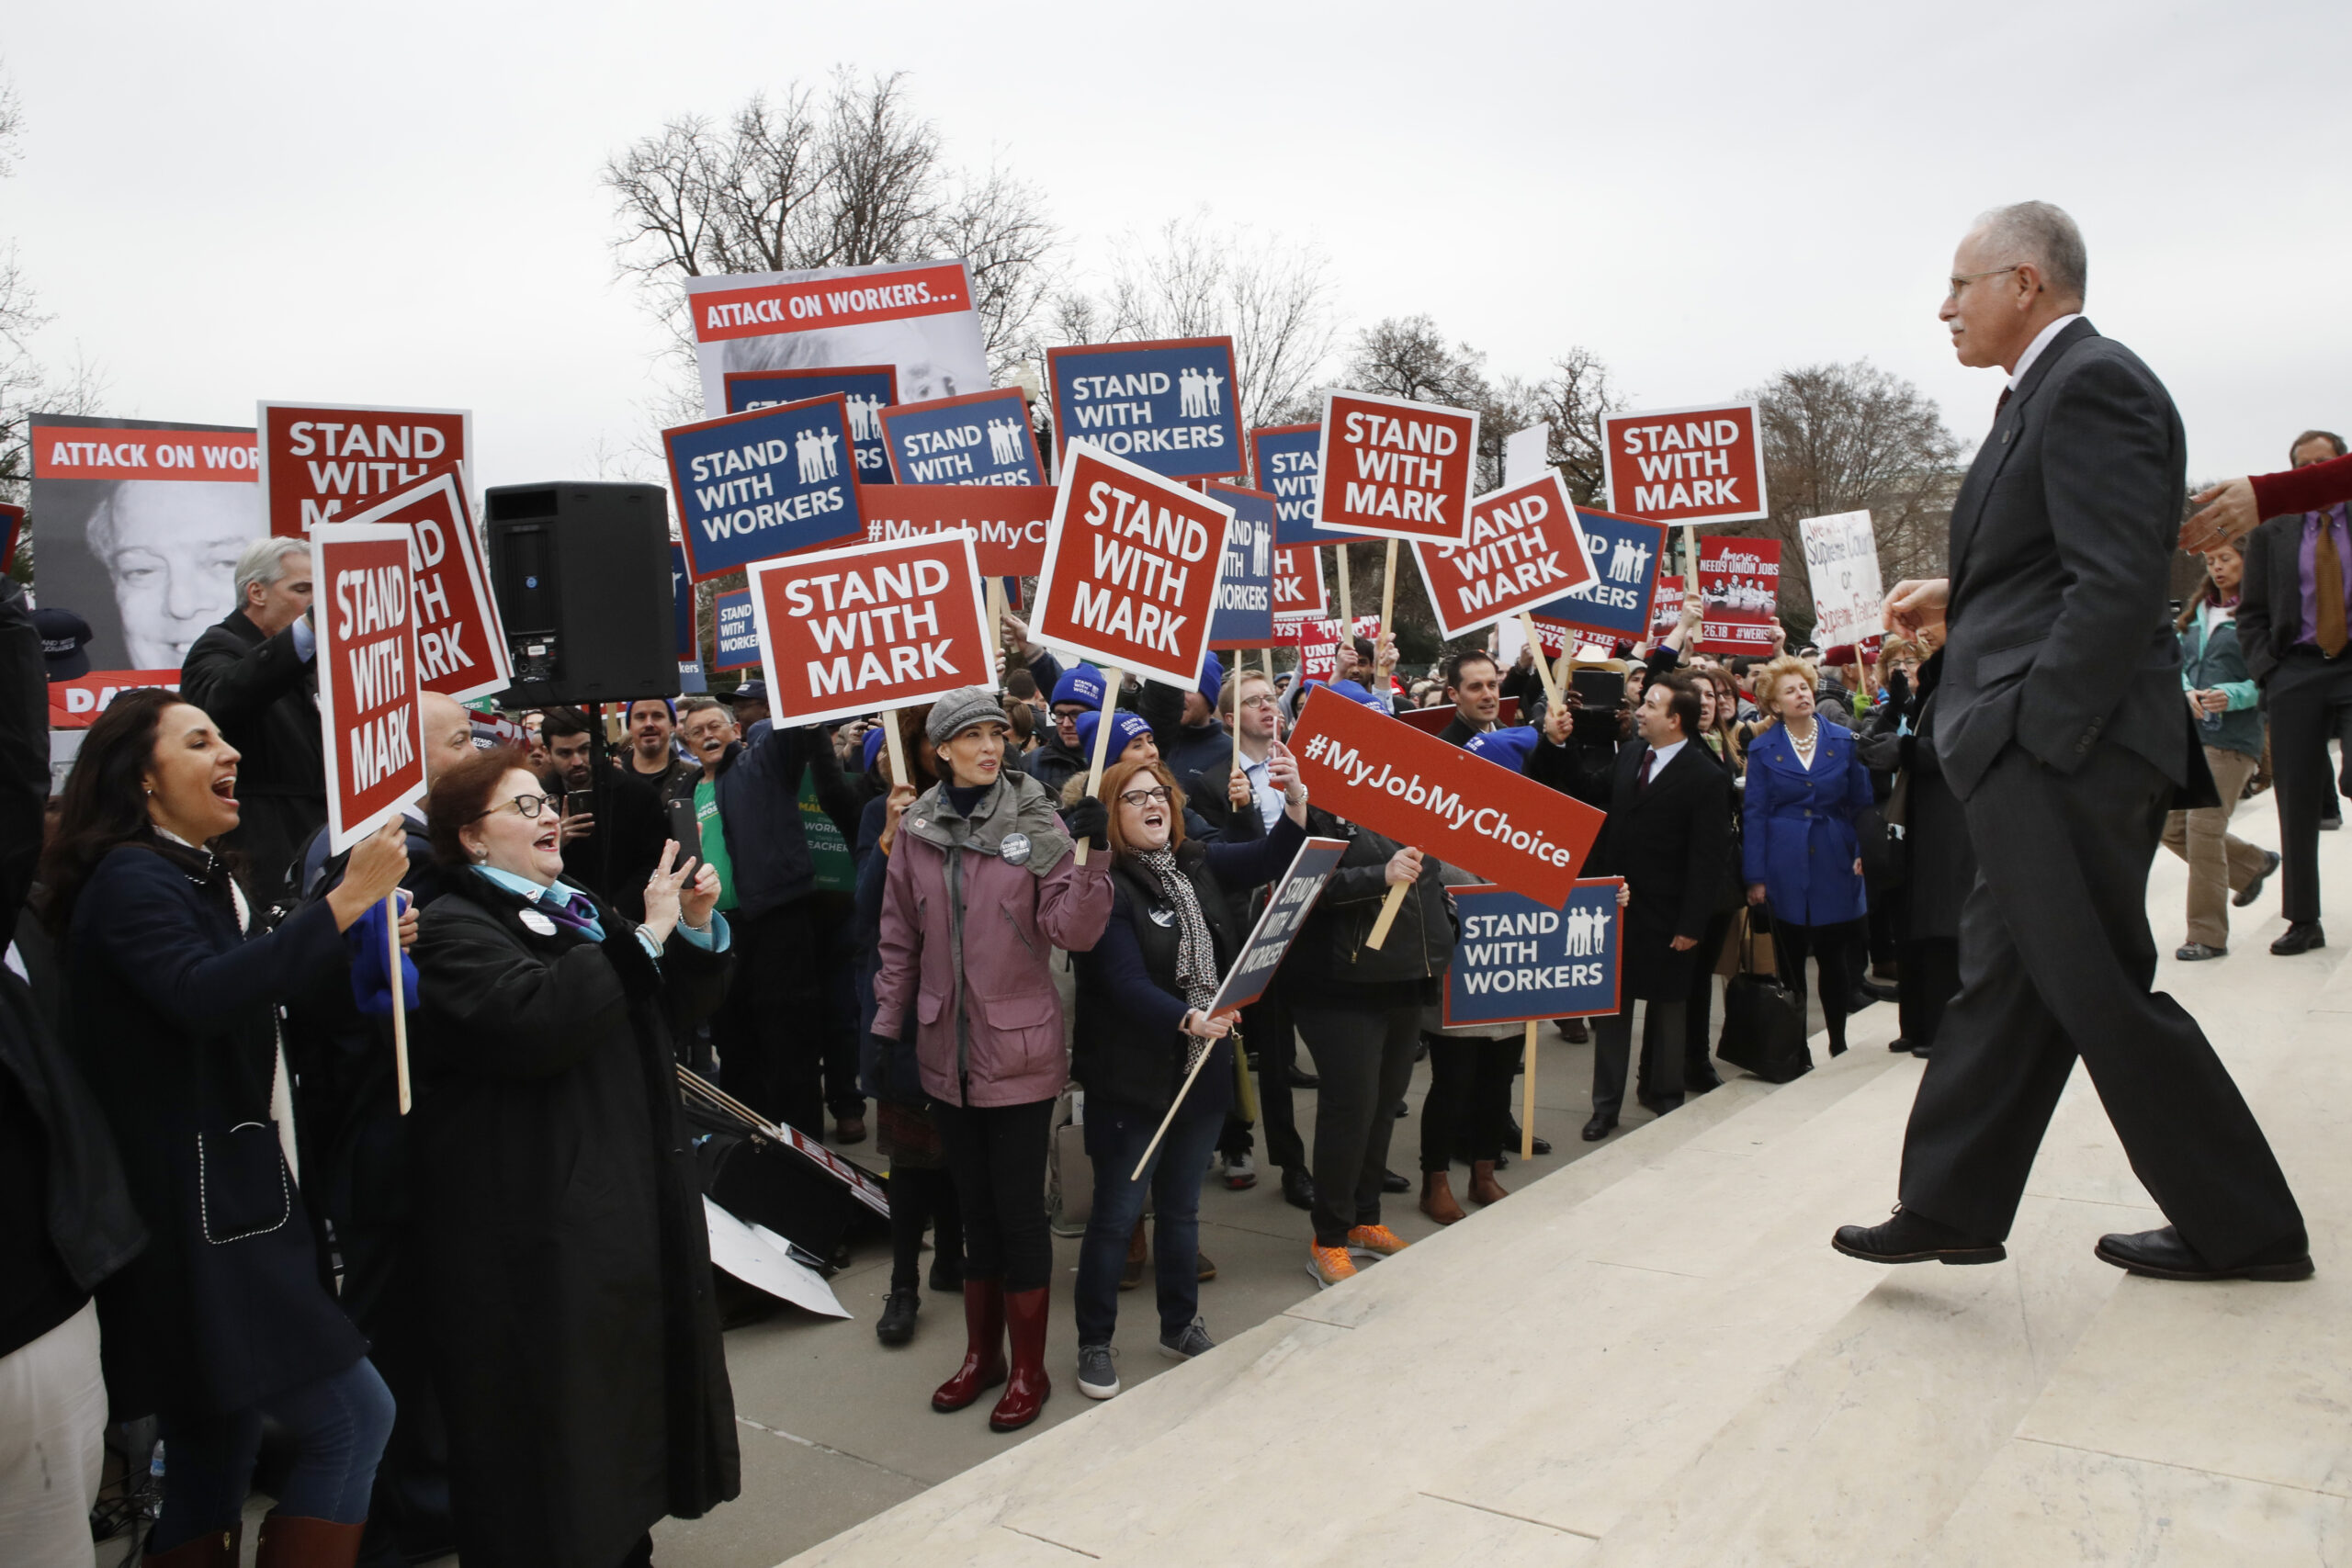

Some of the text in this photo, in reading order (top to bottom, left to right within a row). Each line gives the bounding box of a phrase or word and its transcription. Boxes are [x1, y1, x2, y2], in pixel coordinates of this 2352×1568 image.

[707, 282, 956, 329] ATTACK ON WORKERS...
[1072, 372, 1170, 400] STAND
[1074, 401, 1152, 428] WITH
[289, 421, 446, 458] STAND
[904, 425, 982, 457] STAND
[1344, 412, 1457, 456] STAND
[1623, 419, 1739, 455] STAND
[51, 442, 148, 467] ATTACK
[155, 445, 195, 468] ON
[691, 439, 787, 481] STAND
[909, 453, 974, 482] WITH
[1272, 451, 1320, 473] STA
[1355, 447, 1442, 489] WITH
[1637, 449, 1729, 482] WITH
[307, 460, 428, 494] WITH
[695, 472, 774, 512] WITH
[1272, 475, 1317, 497] WIT
[1345, 481, 1448, 525] MARK
[1634, 478, 1741, 512] MARK
[702, 486, 843, 542] WORKERS
[1084, 481, 1208, 562] STAND
[1094, 533, 1188, 607] WITH
[1223, 551, 1244, 578] ITH
[1453, 525, 1548, 581] WITH
[1700, 559, 1779, 575] NEEDS UNION JOBS
[1720, 547, 1761, 563] America
[786, 559, 949, 616] STAND
[1457, 551, 1568, 614] MARK
[1841, 570, 1852, 590] or
[336, 564, 405, 641] STAND
[720, 604, 752, 622] STAND
[1070, 580, 1187, 657] MARK
[720, 620, 745, 637] WITH
[720, 634, 759, 653] WORKE
[807, 600, 939, 654] WITH
[1586, 631, 1616, 647] THE
[1736, 628, 1769, 640] #WERIS
[348, 635, 405, 716] WITH
[679, 663, 699, 673] kers
[807, 638, 961, 698] MARK
[350, 703, 413, 795] MARK
[1305, 733, 1570, 867] #MyJobMyChoice
[1279, 876, 1316, 905] STAND
[1260, 910, 1293, 940] WITH
[1464, 911, 1559, 939] STAND
[1239, 939, 1289, 976] WORKERS
[1464, 941, 1537, 966] WITH
[1464, 963, 1603, 995] WORKERS
